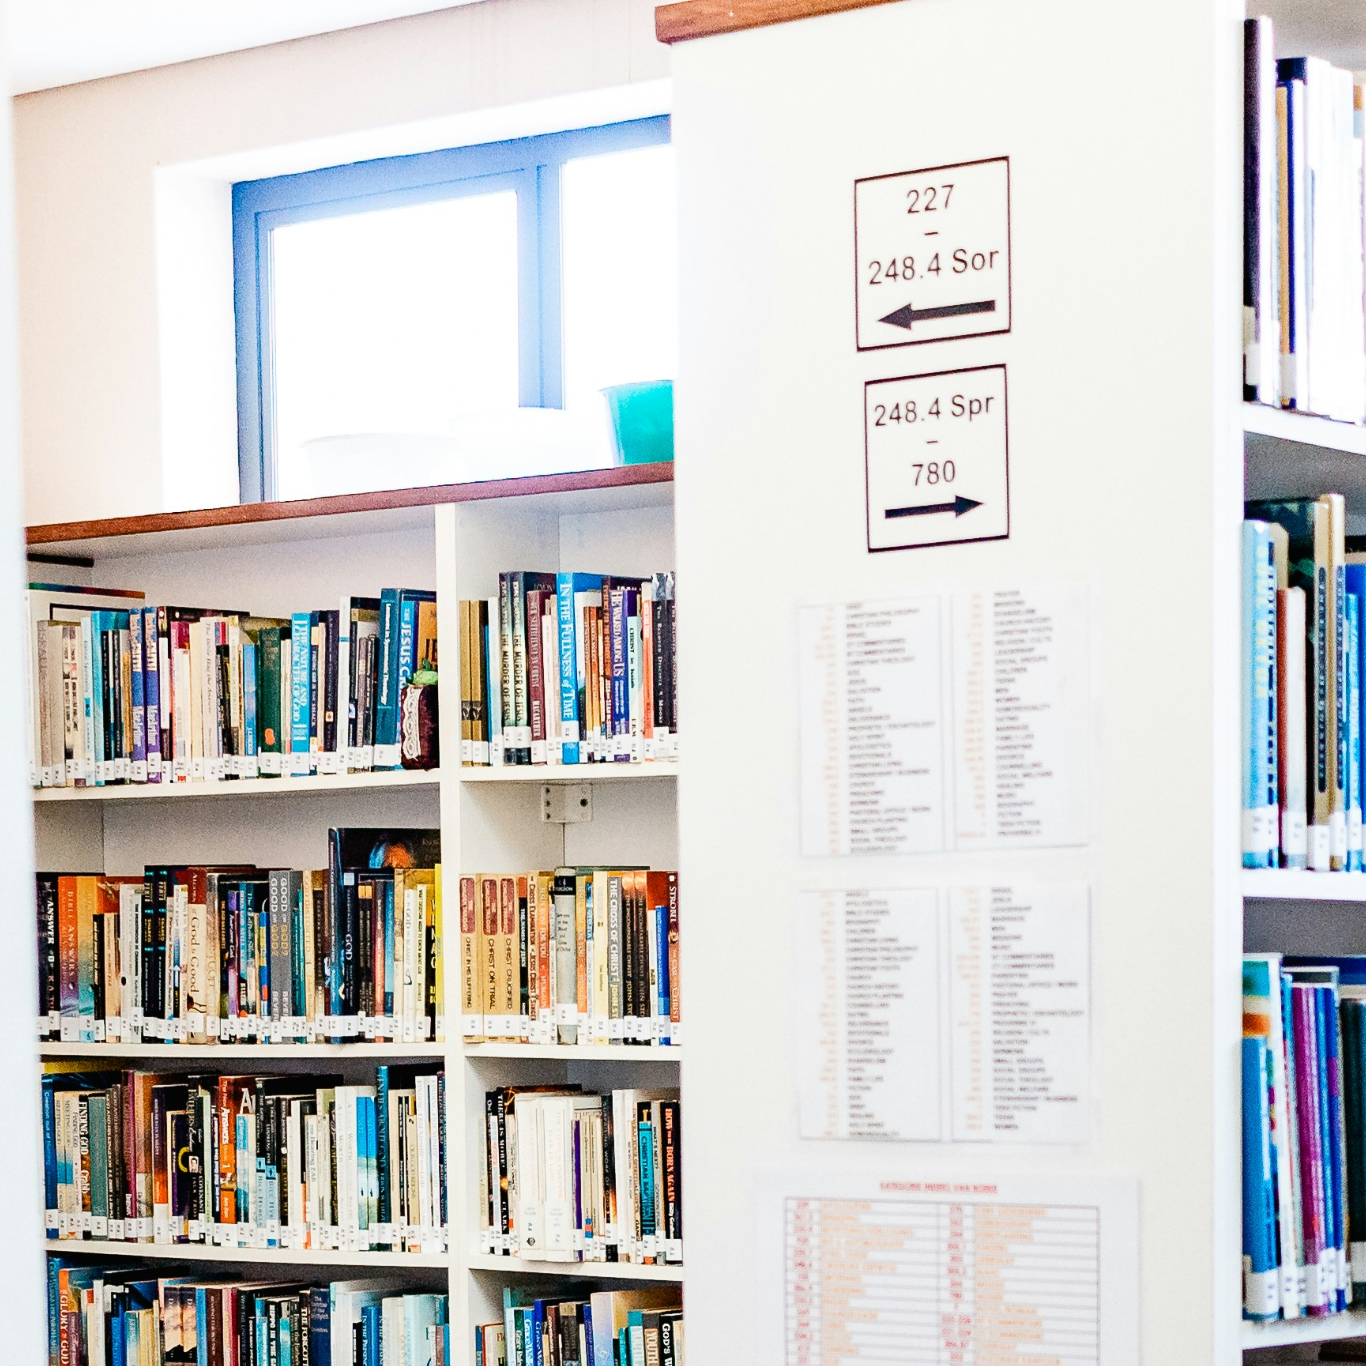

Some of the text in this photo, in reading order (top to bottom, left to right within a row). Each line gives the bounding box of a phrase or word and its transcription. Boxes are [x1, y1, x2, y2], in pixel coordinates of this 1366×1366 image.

[906, 184, 955, 214] 227
[868, 248, 999, 285] 248.4 Sor
[874, 394, 995, 427] 248.4 Spr
[911, 460, 956, 486] 780
[560, 584, 572, 599] IN
[561, 601, 571, 620] THE
[400, 623, 411, 665] JESUS
[502, 634, 510, 647] THE
[561, 624, 573, 676] FULLNESS
[502, 651, 510, 685] MURDER
[513, 651, 522, 685] MURDER
[563, 692, 574, 718] TIME
[280, 878, 288, 912] GOOD
[610, 880, 618, 898] THE
[669, 886, 677, 923] STROBEL
[610, 900, 618, 928] CROSS
[610, 930, 618, 942] OF
[191, 917, 200, 993] God Good
[610, 944, 618, 976] CHRIST
[80, 1102, 88, 1135] FINDING
[221, 1107, 230, 1144] Answers
[80, 1137, 88, 1155] GOD
[60, 1296, 69, 1364] GLORY GOD
[270, 1330, 277, 1338] IN
[662, 1323, 672, 1354] GOD'S
[646, 1332, 658, 1363] YOUTH
